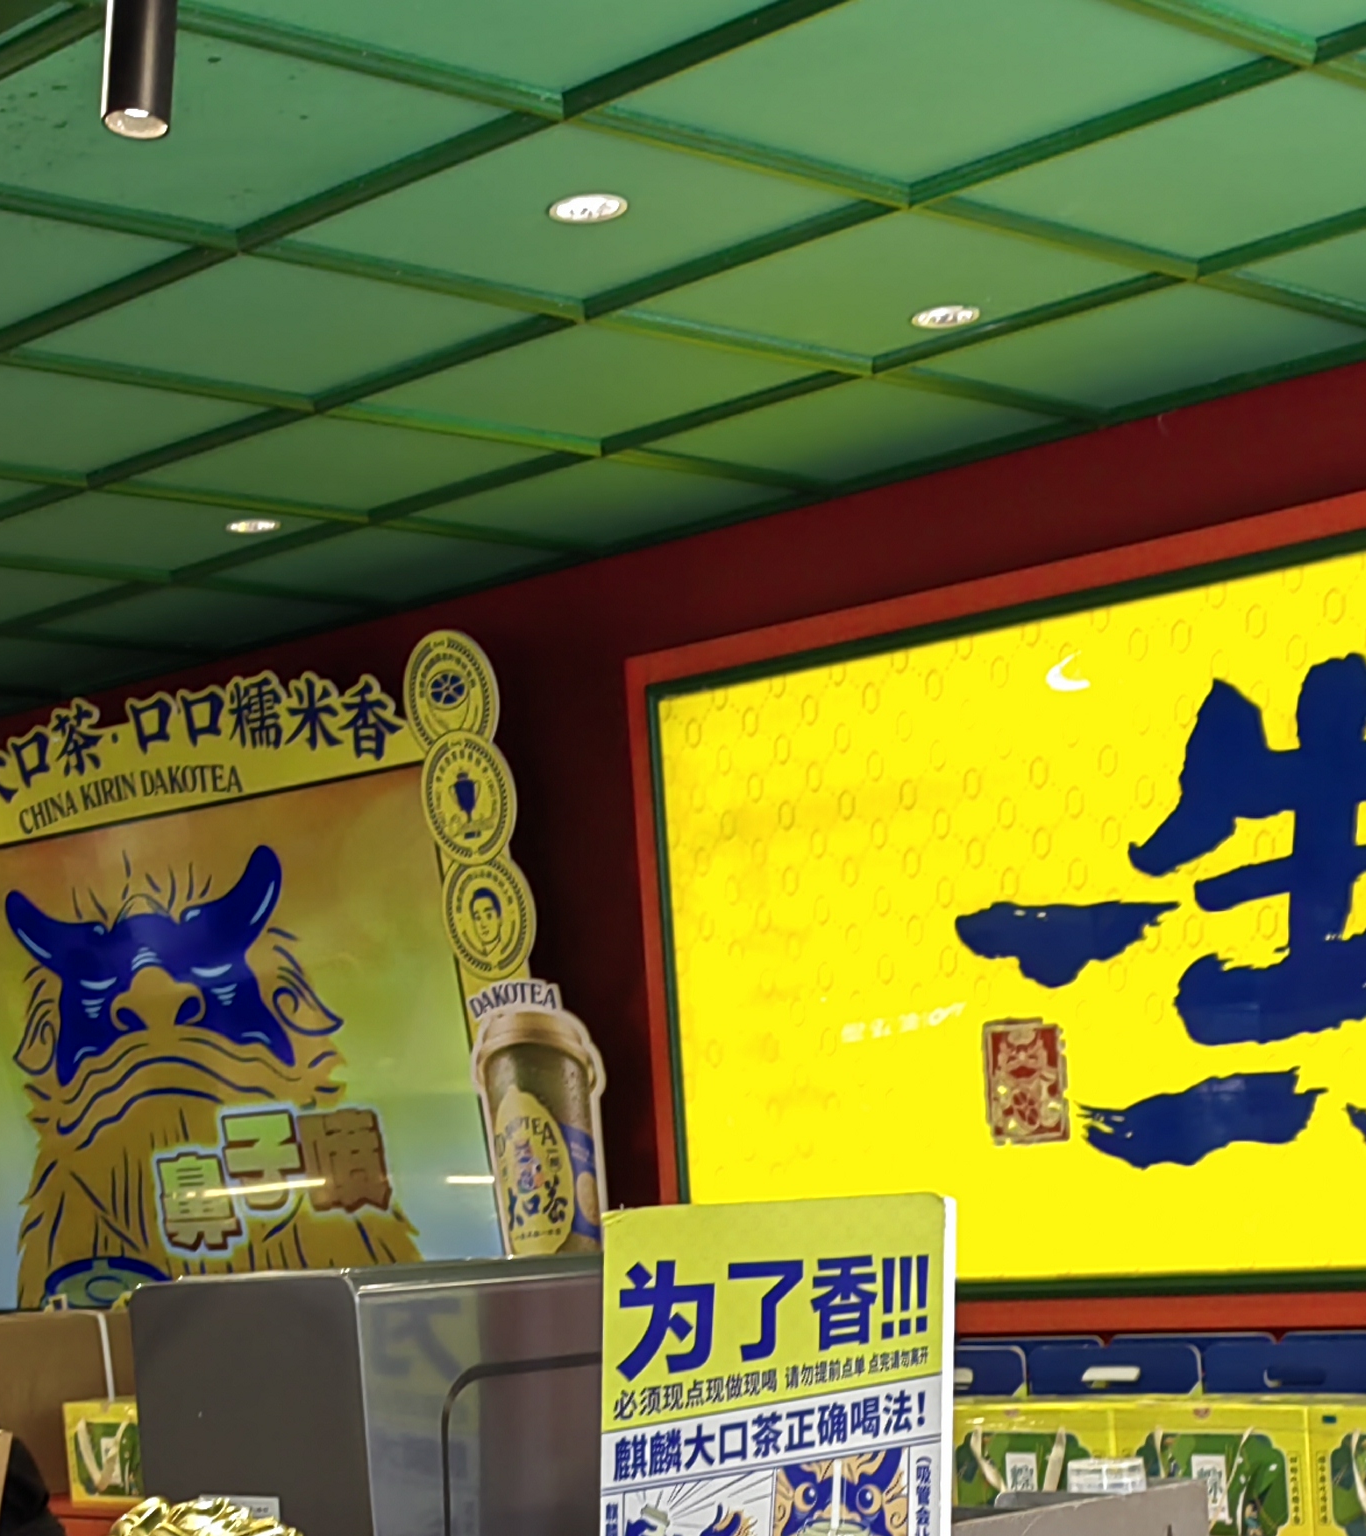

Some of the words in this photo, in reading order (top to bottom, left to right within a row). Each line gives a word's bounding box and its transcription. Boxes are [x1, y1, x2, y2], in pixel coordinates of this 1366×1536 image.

[18, 784, 81, 836] CHINA
[81, 771, 137, 812] KIRIN
[139, 764, 244, 797] DAKOTEA
[468, 980, 558, 1020] DAKOTEA
[616, 1252, 931, 1383] 为了香!!!
[613, 1370, 778, 1421] 必须现点现做现喝
[785, 1359, 867, 1391] 请勿提前点单
[867, 1345, 930, 1374] 点完请勿离开
[612, 1389, 927, 1482] 麒麟大口茶正确喝法!
